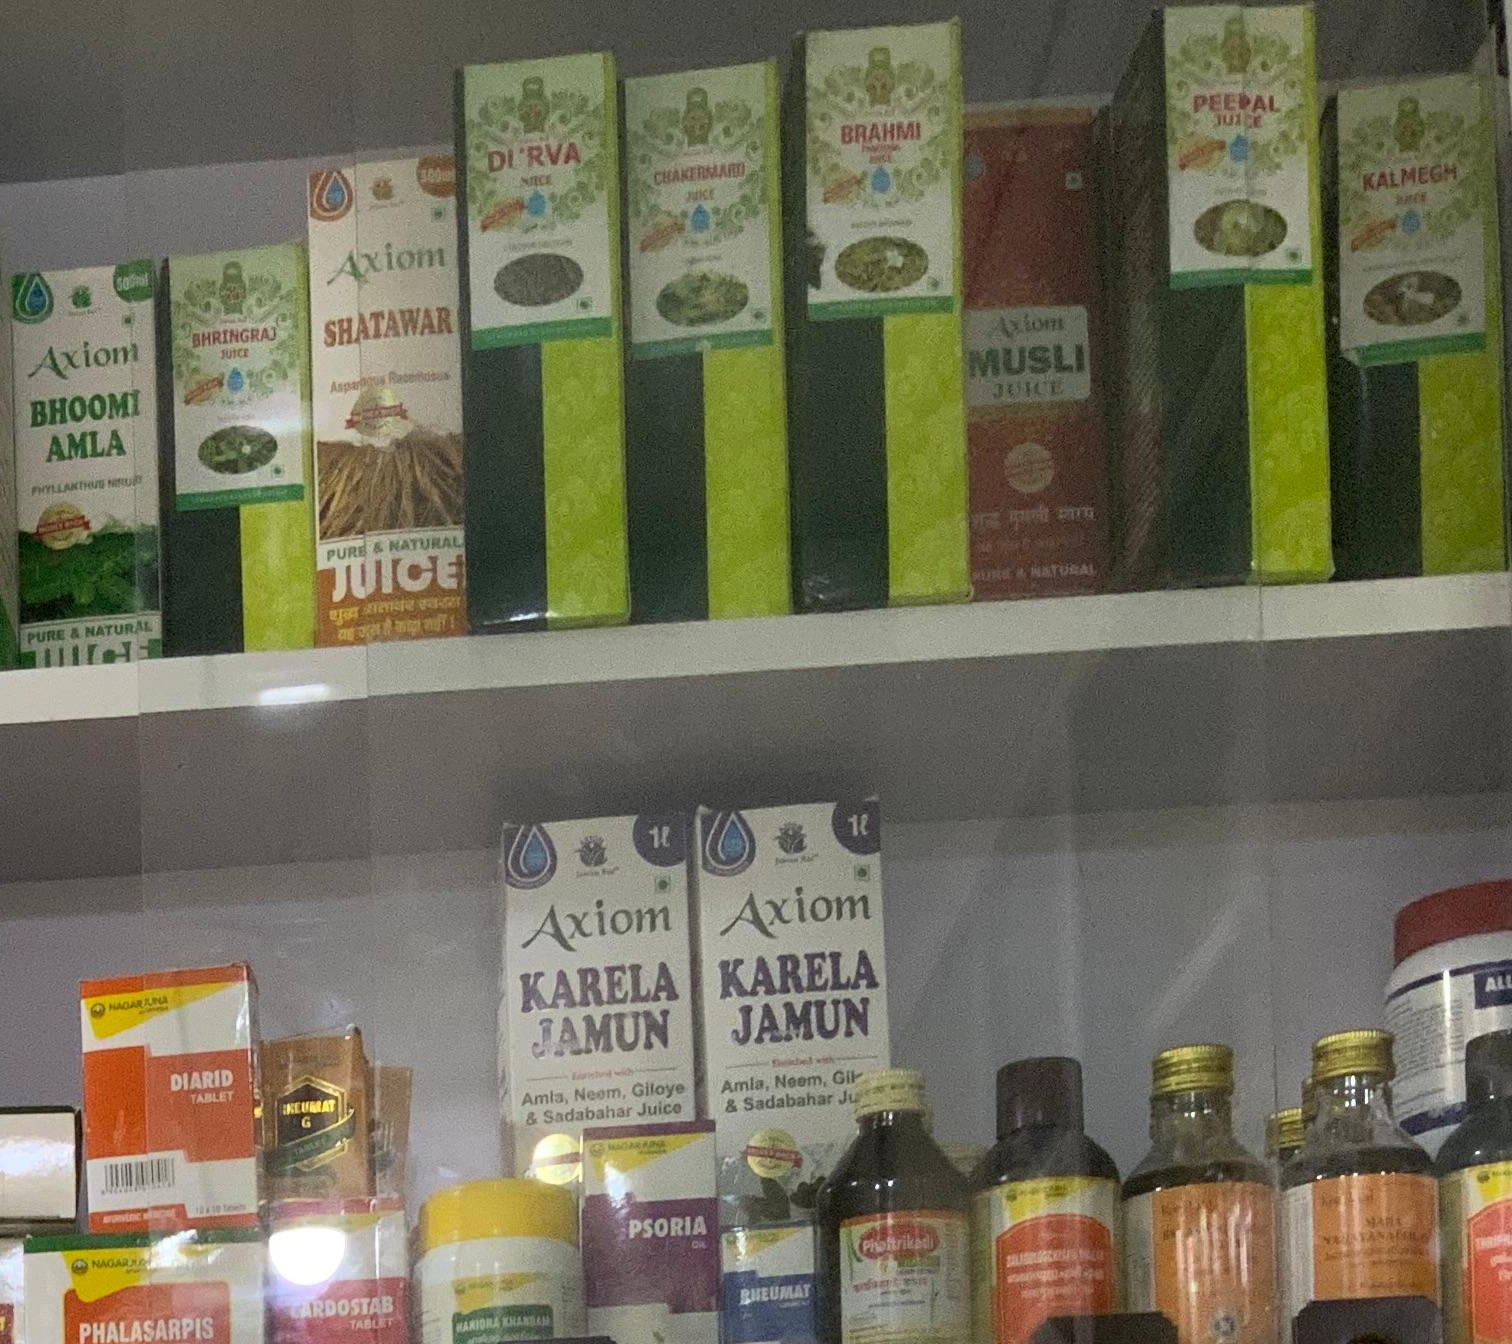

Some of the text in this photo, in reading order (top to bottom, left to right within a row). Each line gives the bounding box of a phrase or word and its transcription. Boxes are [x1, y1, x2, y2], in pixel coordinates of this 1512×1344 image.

[1192, 92, 1281, 115] PEEPAL
[840, 121, 921, 146] BRAHMI
[1361, 163, 1458, 193] KALMEGH
[327, 243, 446, 286] Axiom
[191, 328, 278, 348] BHRINGRAJ
[324, 307, 453, 348] SHATAWAR
[28, 342, 140, 380] Axiom
[967, 342, 1086, 379] MUSLI
[30, 390, 140, 428] BHOOMI
[45, 430, 127, 463] AMLA
[326, 535, 464, 563] PURE NATURAL
[331, 554, 465, 602] JUICE
[26, 620, 154, 645] PURE NATURAL
[521, 899, 672, 953] Axiom
[720, 885, 871, 939] Axiom
[520, 961, 680, 1014] KARELA
[718, 949, 879, 1000] KARELA
[531, 1008, 670, 1059] JAMUN
[731, 996, 870, 1046] JAMUN
[170, 1069, 234, 1093] DIARID
[574, 1080, 686, 1103] Neem, Giloye
[720, 1072, 827, 1095] Amla, Neem,
[189, 1091, 234, 1105] TABLET
[543, 1100, 683, 1123] Sadabahar Juice
[743, 1090, 832, 1112] Sadabahar
[628, 1215, 707, 1240] PSORIA
[78, 1317, 215, 1344] PHALASARPIS
[350, 1317, 394, 1330] TABLET
